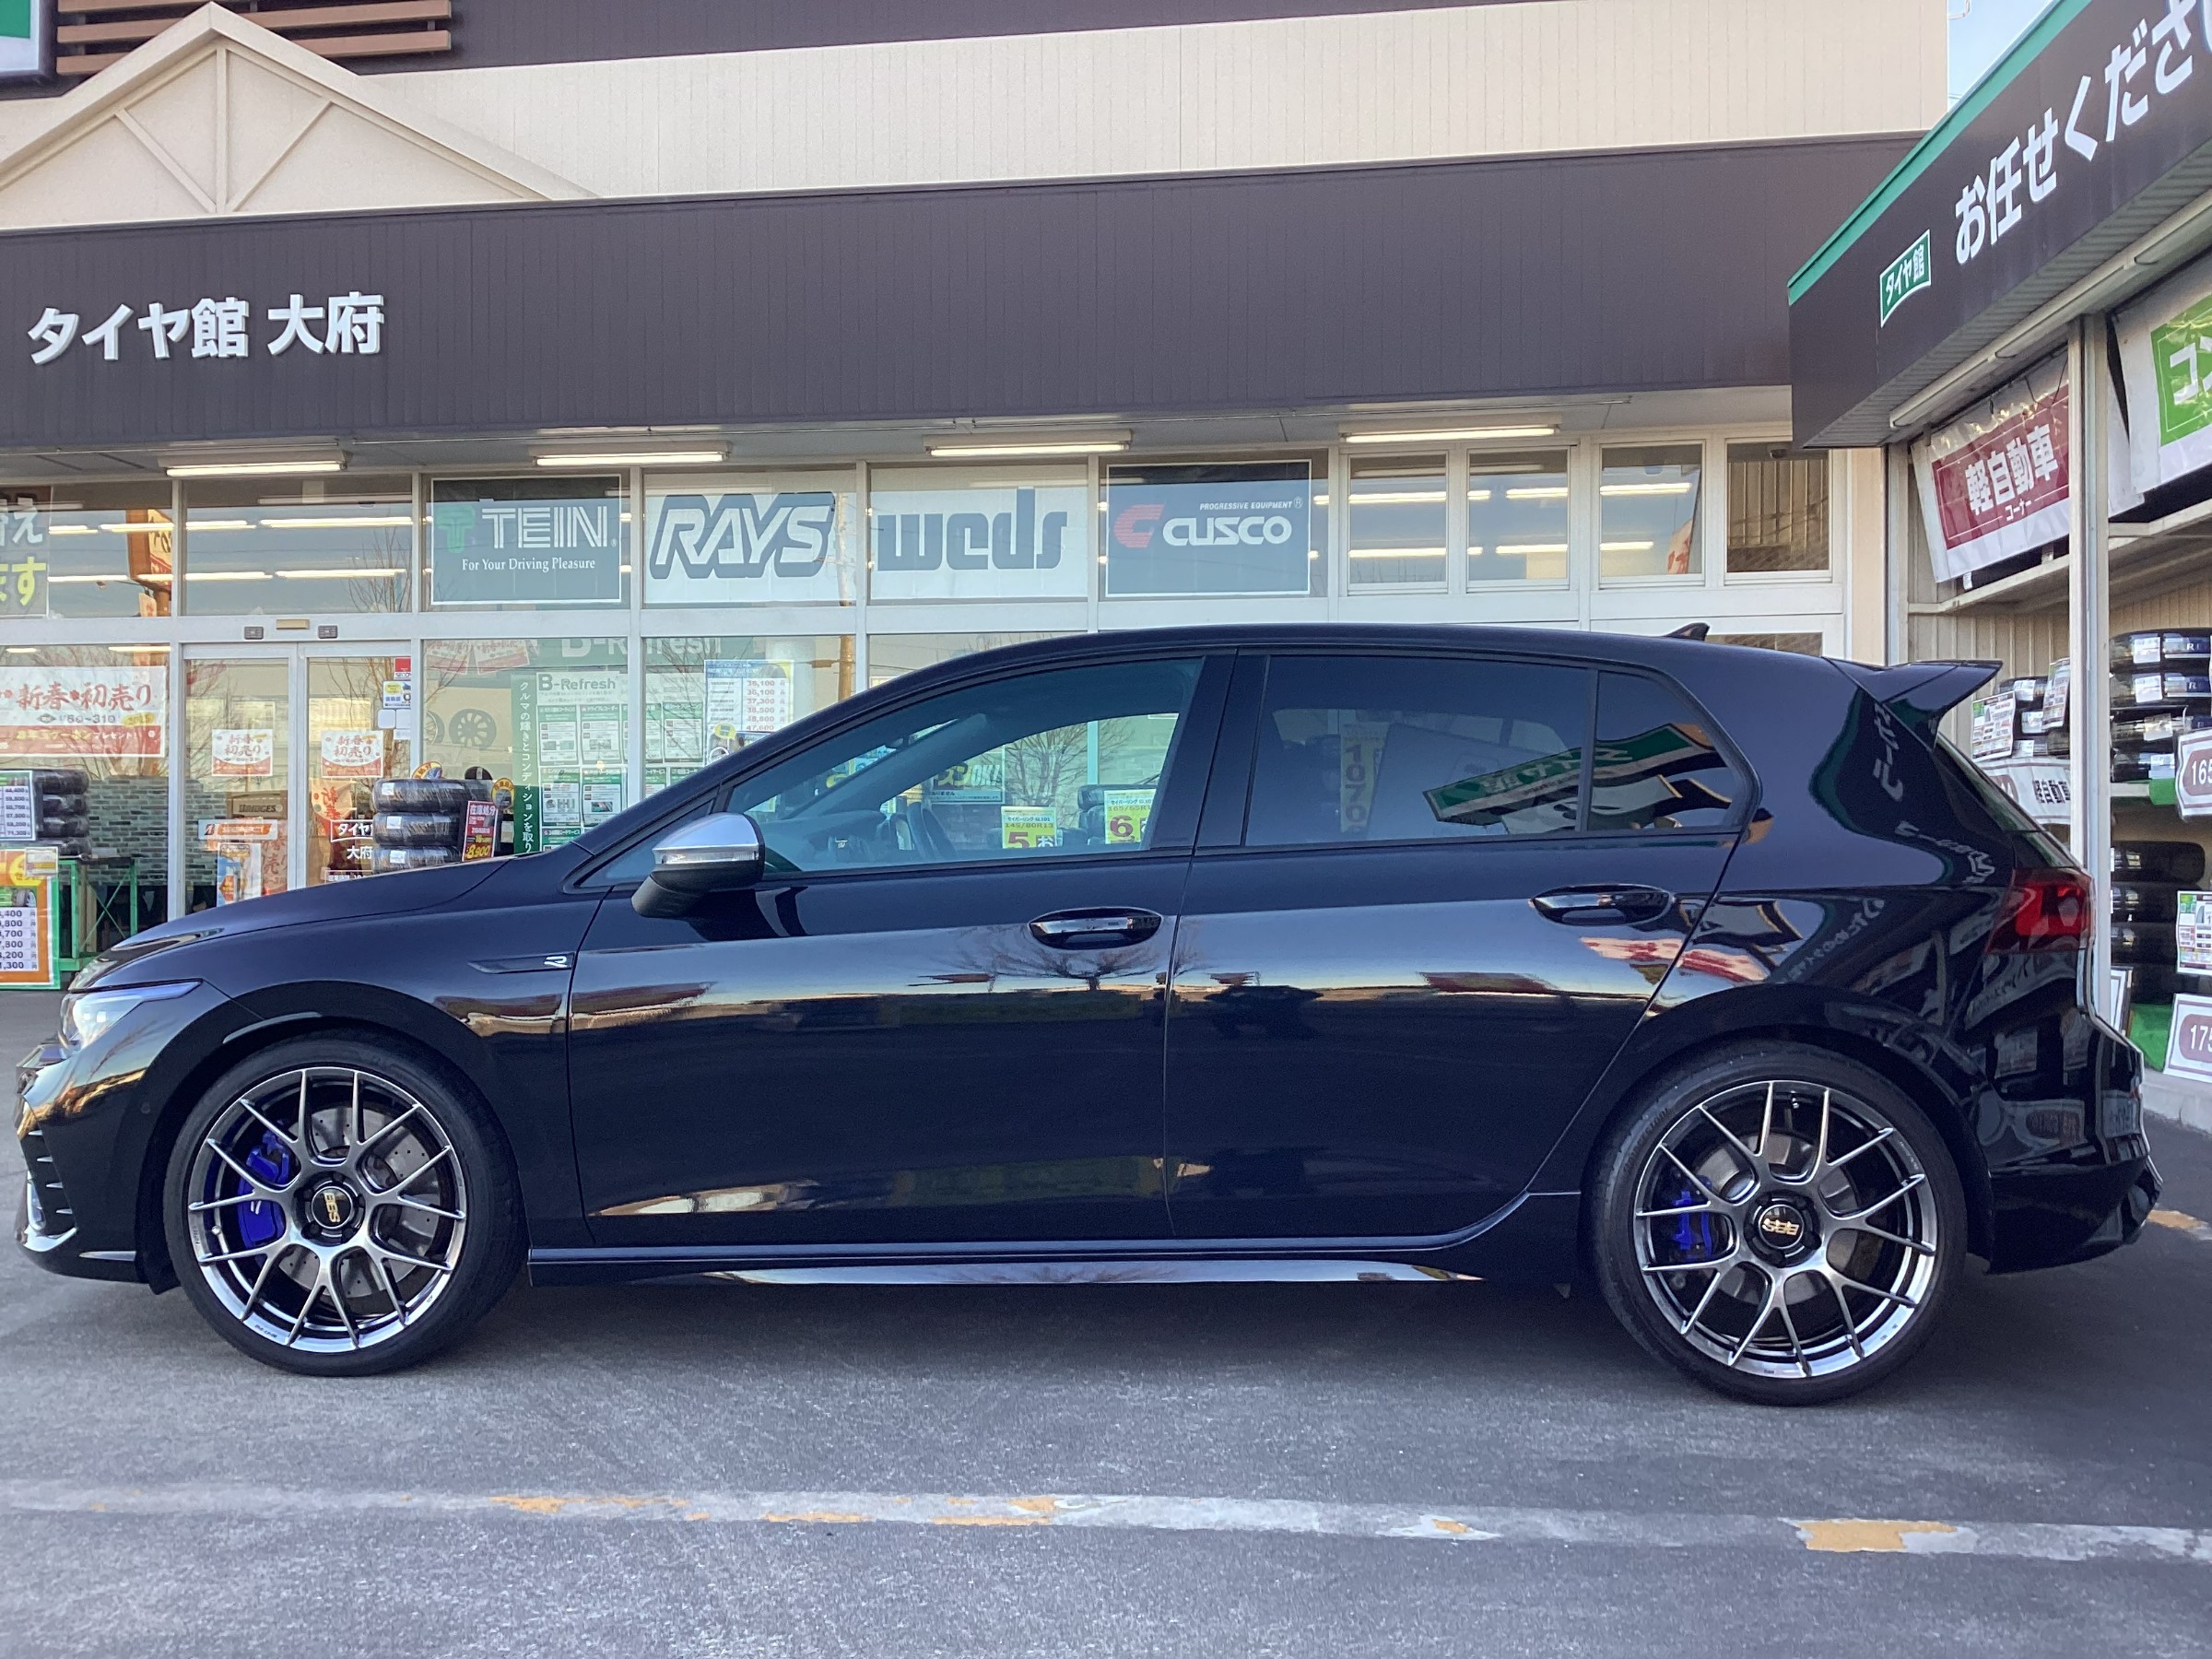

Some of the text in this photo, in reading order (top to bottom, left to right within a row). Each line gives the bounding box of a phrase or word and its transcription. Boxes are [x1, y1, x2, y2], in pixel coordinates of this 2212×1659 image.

[1955, 0, 2212, 265] お任せくださ
[1885, 244, 1925, 306] タイヤ館
[28, 291, 385, 365] タイヤ館 大府
[1965, 424, 2059, 515] 軽自動車
[0, 498, 42, 544] え
[1199, 500, 1293, 511] PROGRESSIVE EQUIPMENT
[2004, 498, 2031, 521] コーナー
[482, 506, 608, 549] TEIN
[652, 496, 834, 577] RAYS
[877, 487, 1068, 571] weds
[1162, 515, 1292, 547] CUSCO
[462, 558, 595, 572] For Your Driving Pleasure
[0, 557, 46, 605] す
[16, 681, 151, 712] 新春 初売り
[538, 674, 616, 690] B-Refresh
[337, 823, 373, 836] タイヤ
[1110, 815, 1134, 838] 6
[347, 845, 373, 859] 大府
[324, 1192, 341, 1223] BBS
[1761, 1218, 1800, 1235] BBS
